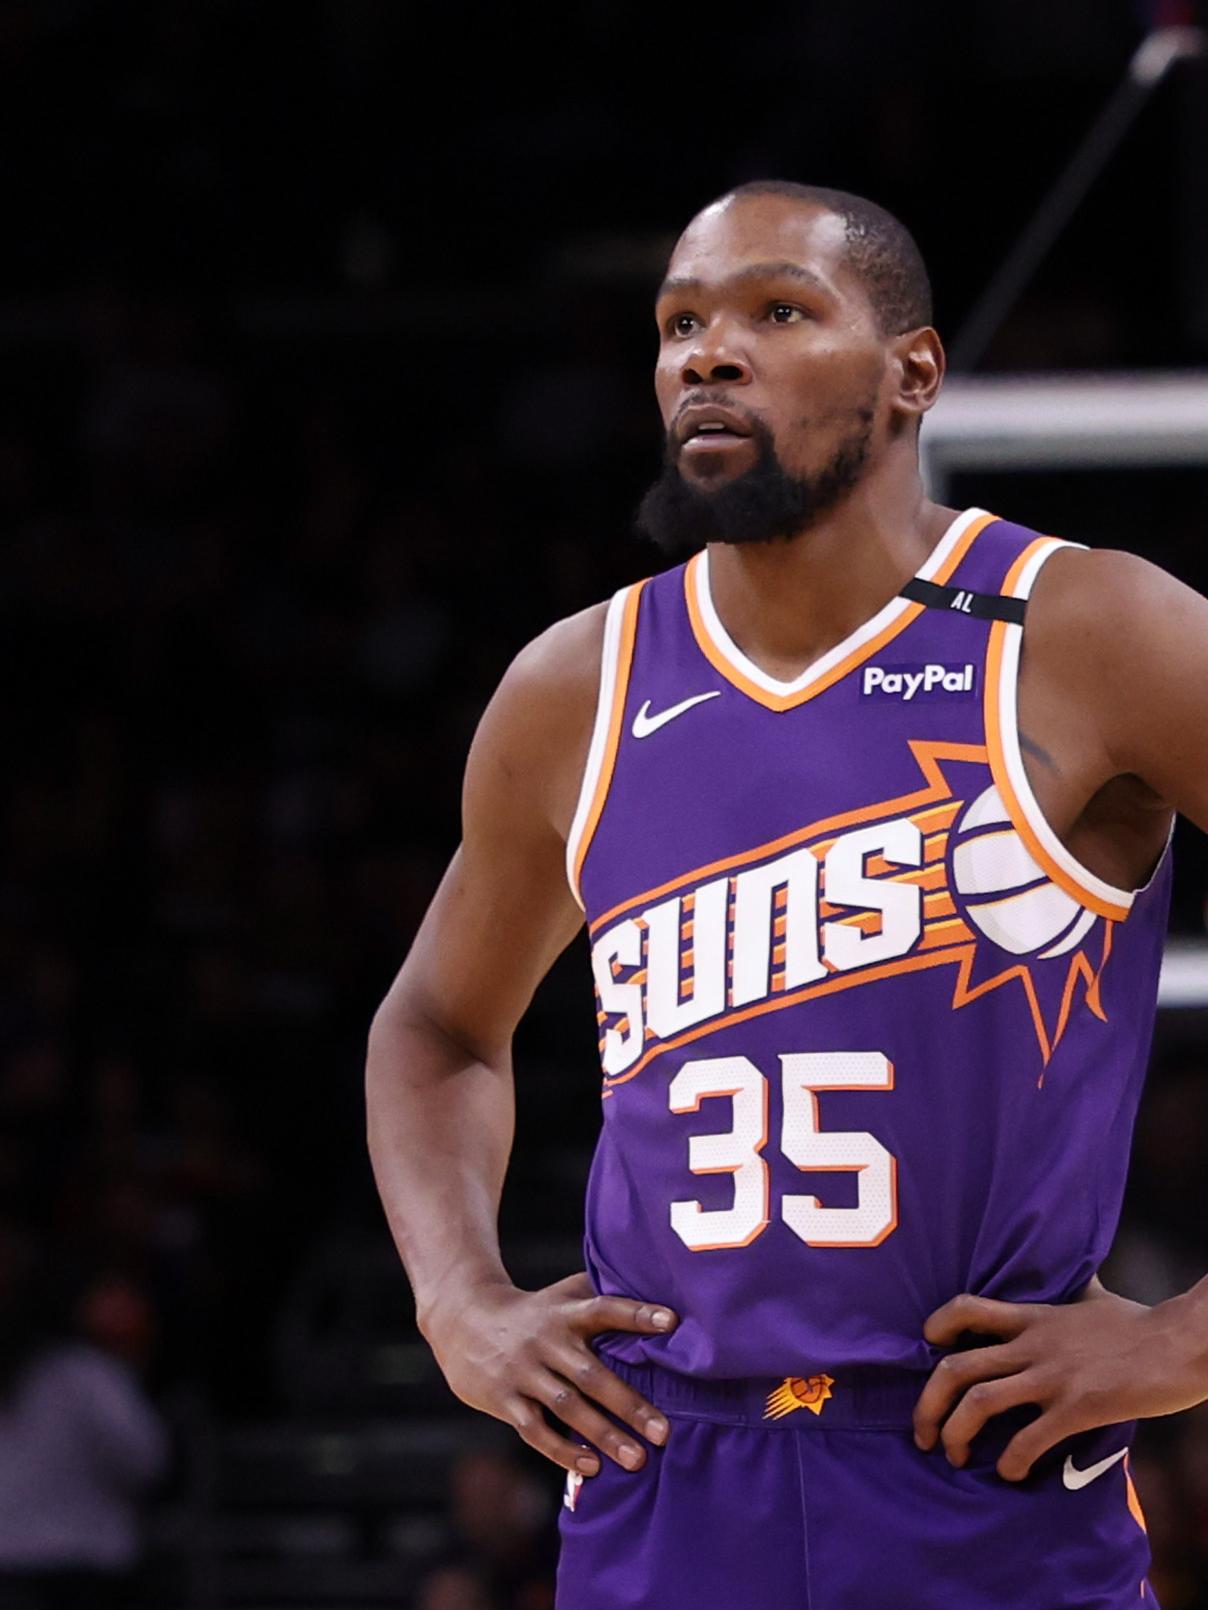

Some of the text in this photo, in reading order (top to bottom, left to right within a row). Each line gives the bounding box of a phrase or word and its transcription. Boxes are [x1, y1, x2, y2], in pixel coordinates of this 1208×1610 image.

[951, 591, 974, 613] AL
[863, 664, 974, 700] PayPal
[669, 1051, 898, 1251] 35
